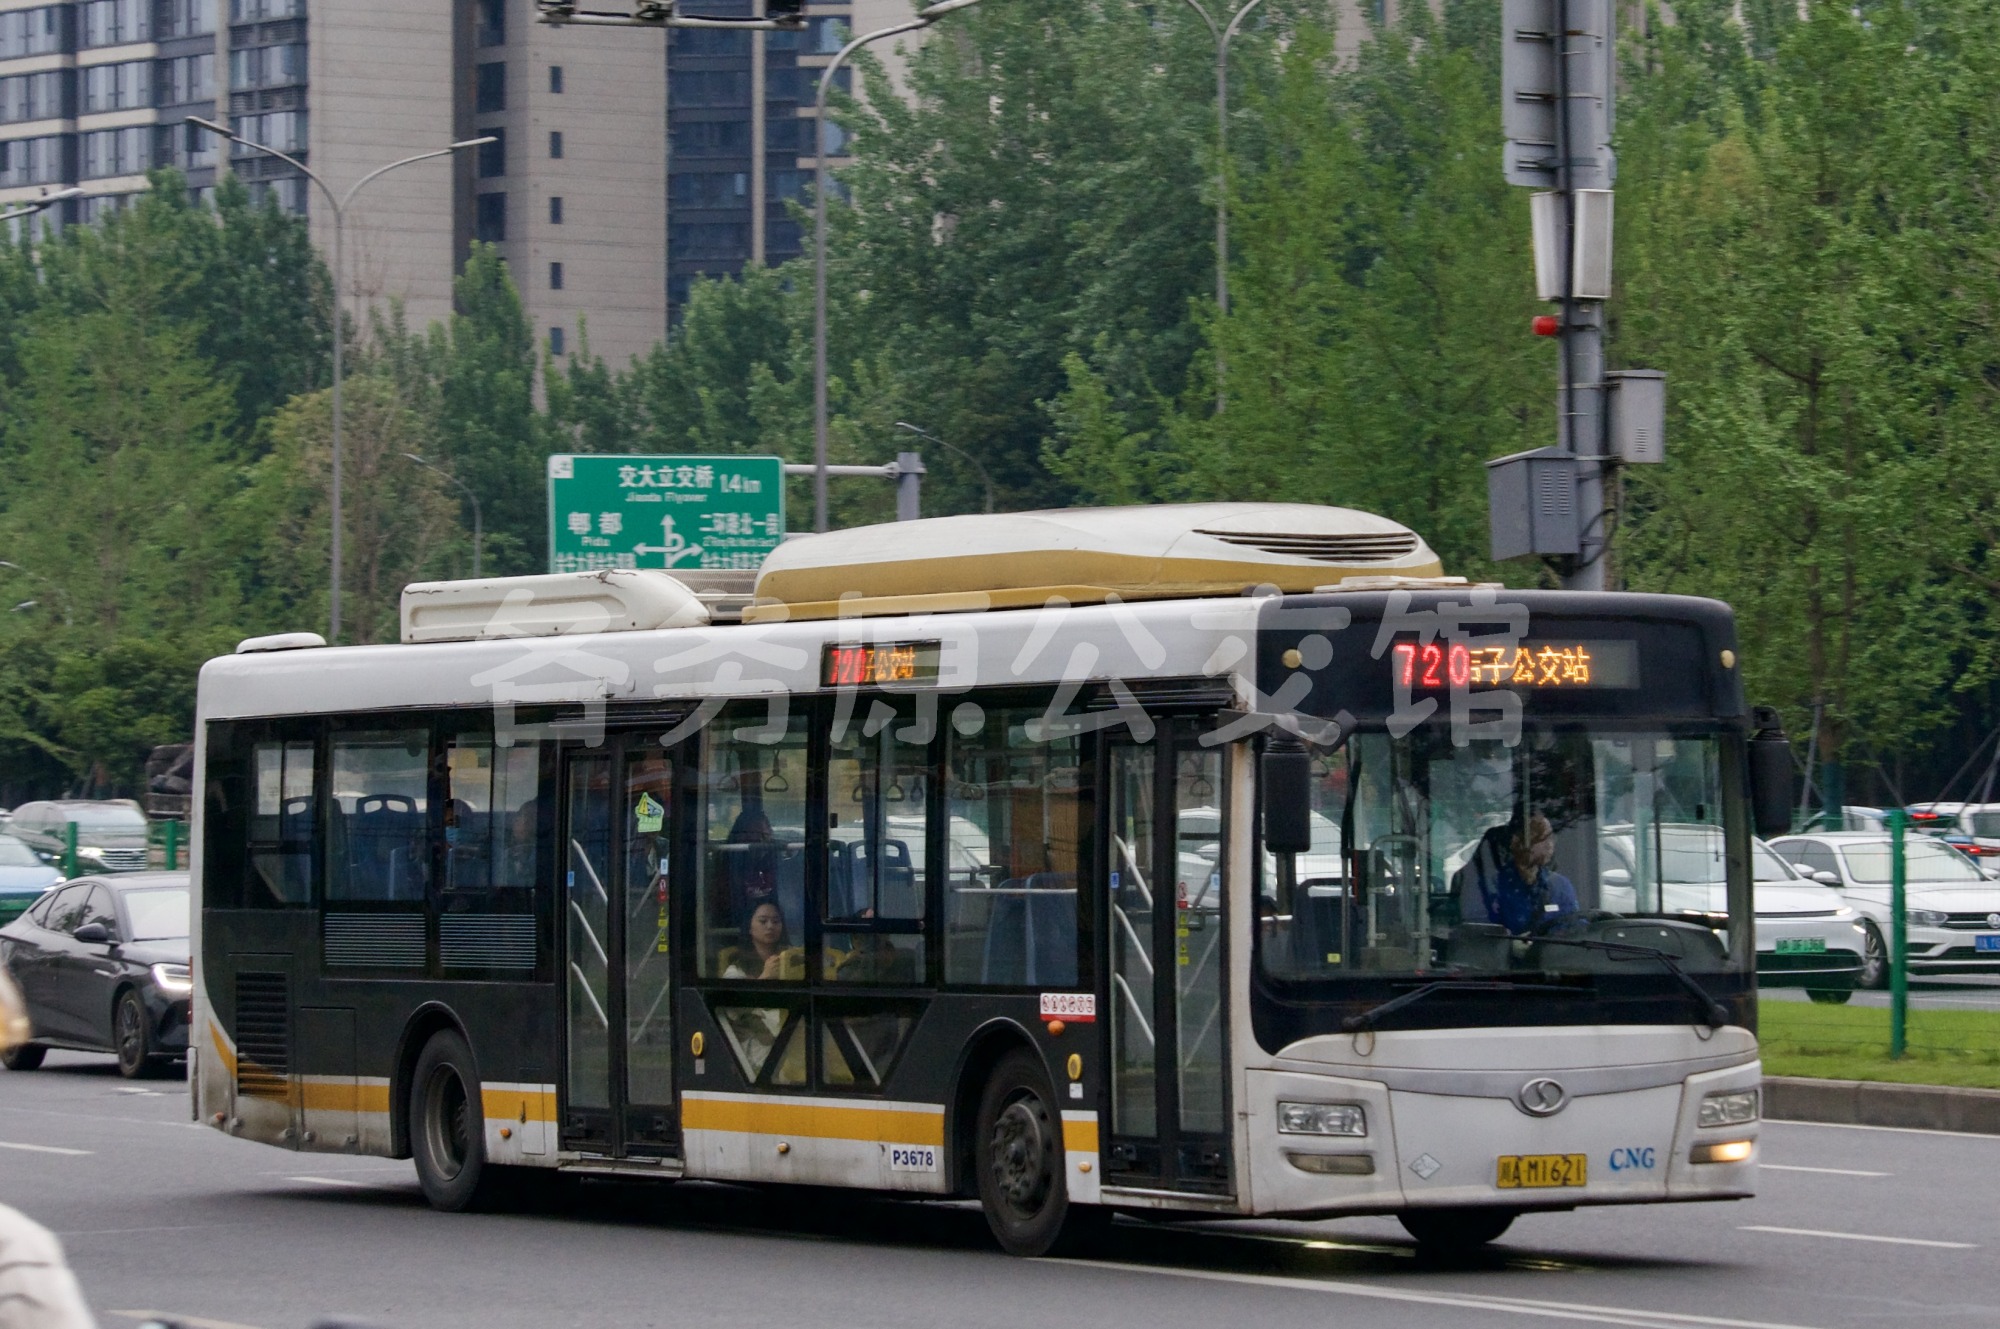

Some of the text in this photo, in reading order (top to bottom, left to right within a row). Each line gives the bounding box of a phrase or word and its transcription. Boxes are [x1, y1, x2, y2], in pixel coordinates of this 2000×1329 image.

[618, 465, 714, 488] 交大立交桥
[829, 648, 867, 684] 720
[1394, 644, 1470, 686] 720
[893, 1150, 933, 1166] P3678
[1609, 1147, 1655, 1171] CNG
